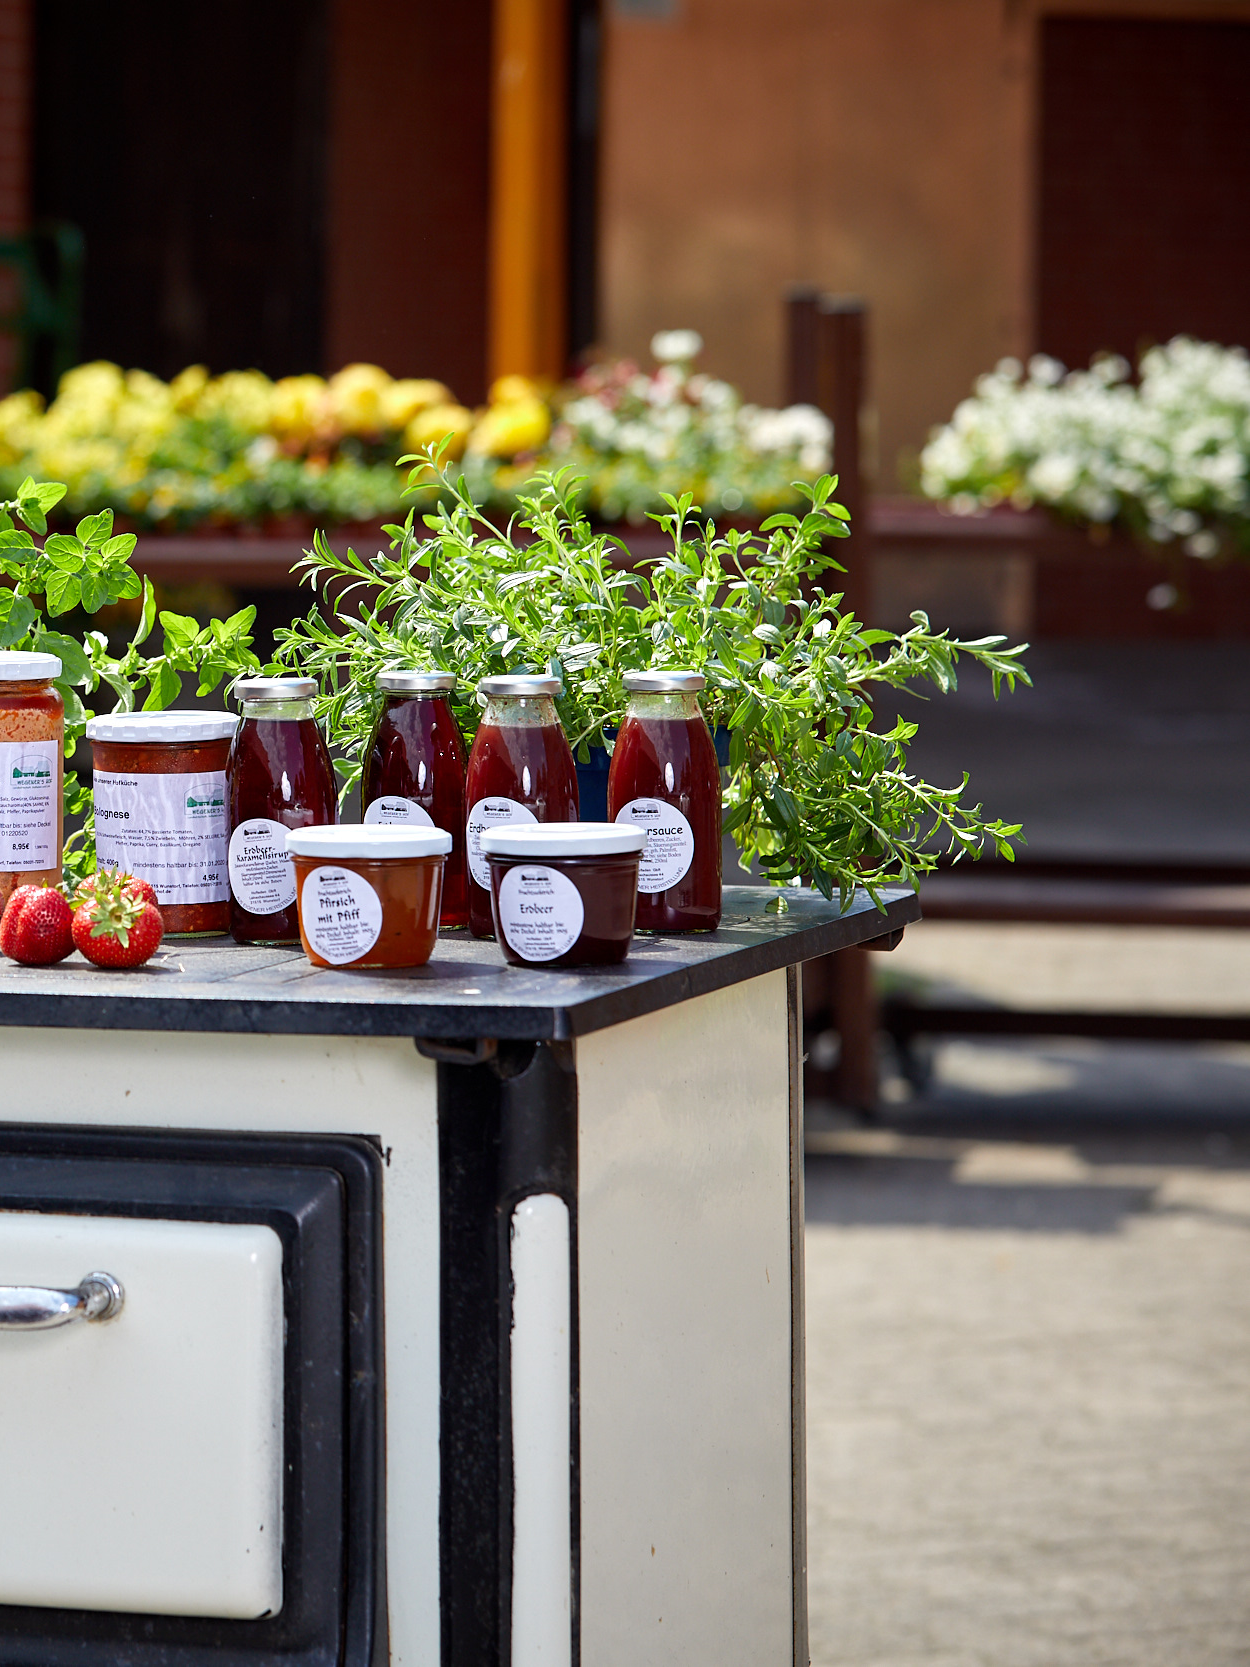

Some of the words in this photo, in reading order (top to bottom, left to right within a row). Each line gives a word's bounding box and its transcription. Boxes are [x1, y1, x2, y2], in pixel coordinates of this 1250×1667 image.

[12, 842, 30, 850] 8,95€
[244, 846, 276, 855] Erdbeer-
[236, 852, 288, 862] Karamellsirup
[202, 873, 219, 882] 4,95€
[650, 866, 684, 890] HERSTELLUNG
[320, 895, 356, 908] Pfirsich
[520, 902, 554, 914] Erdbeer
[318, 914, 332, 924] mit
[337, 908, 360, 922] Pfiff
